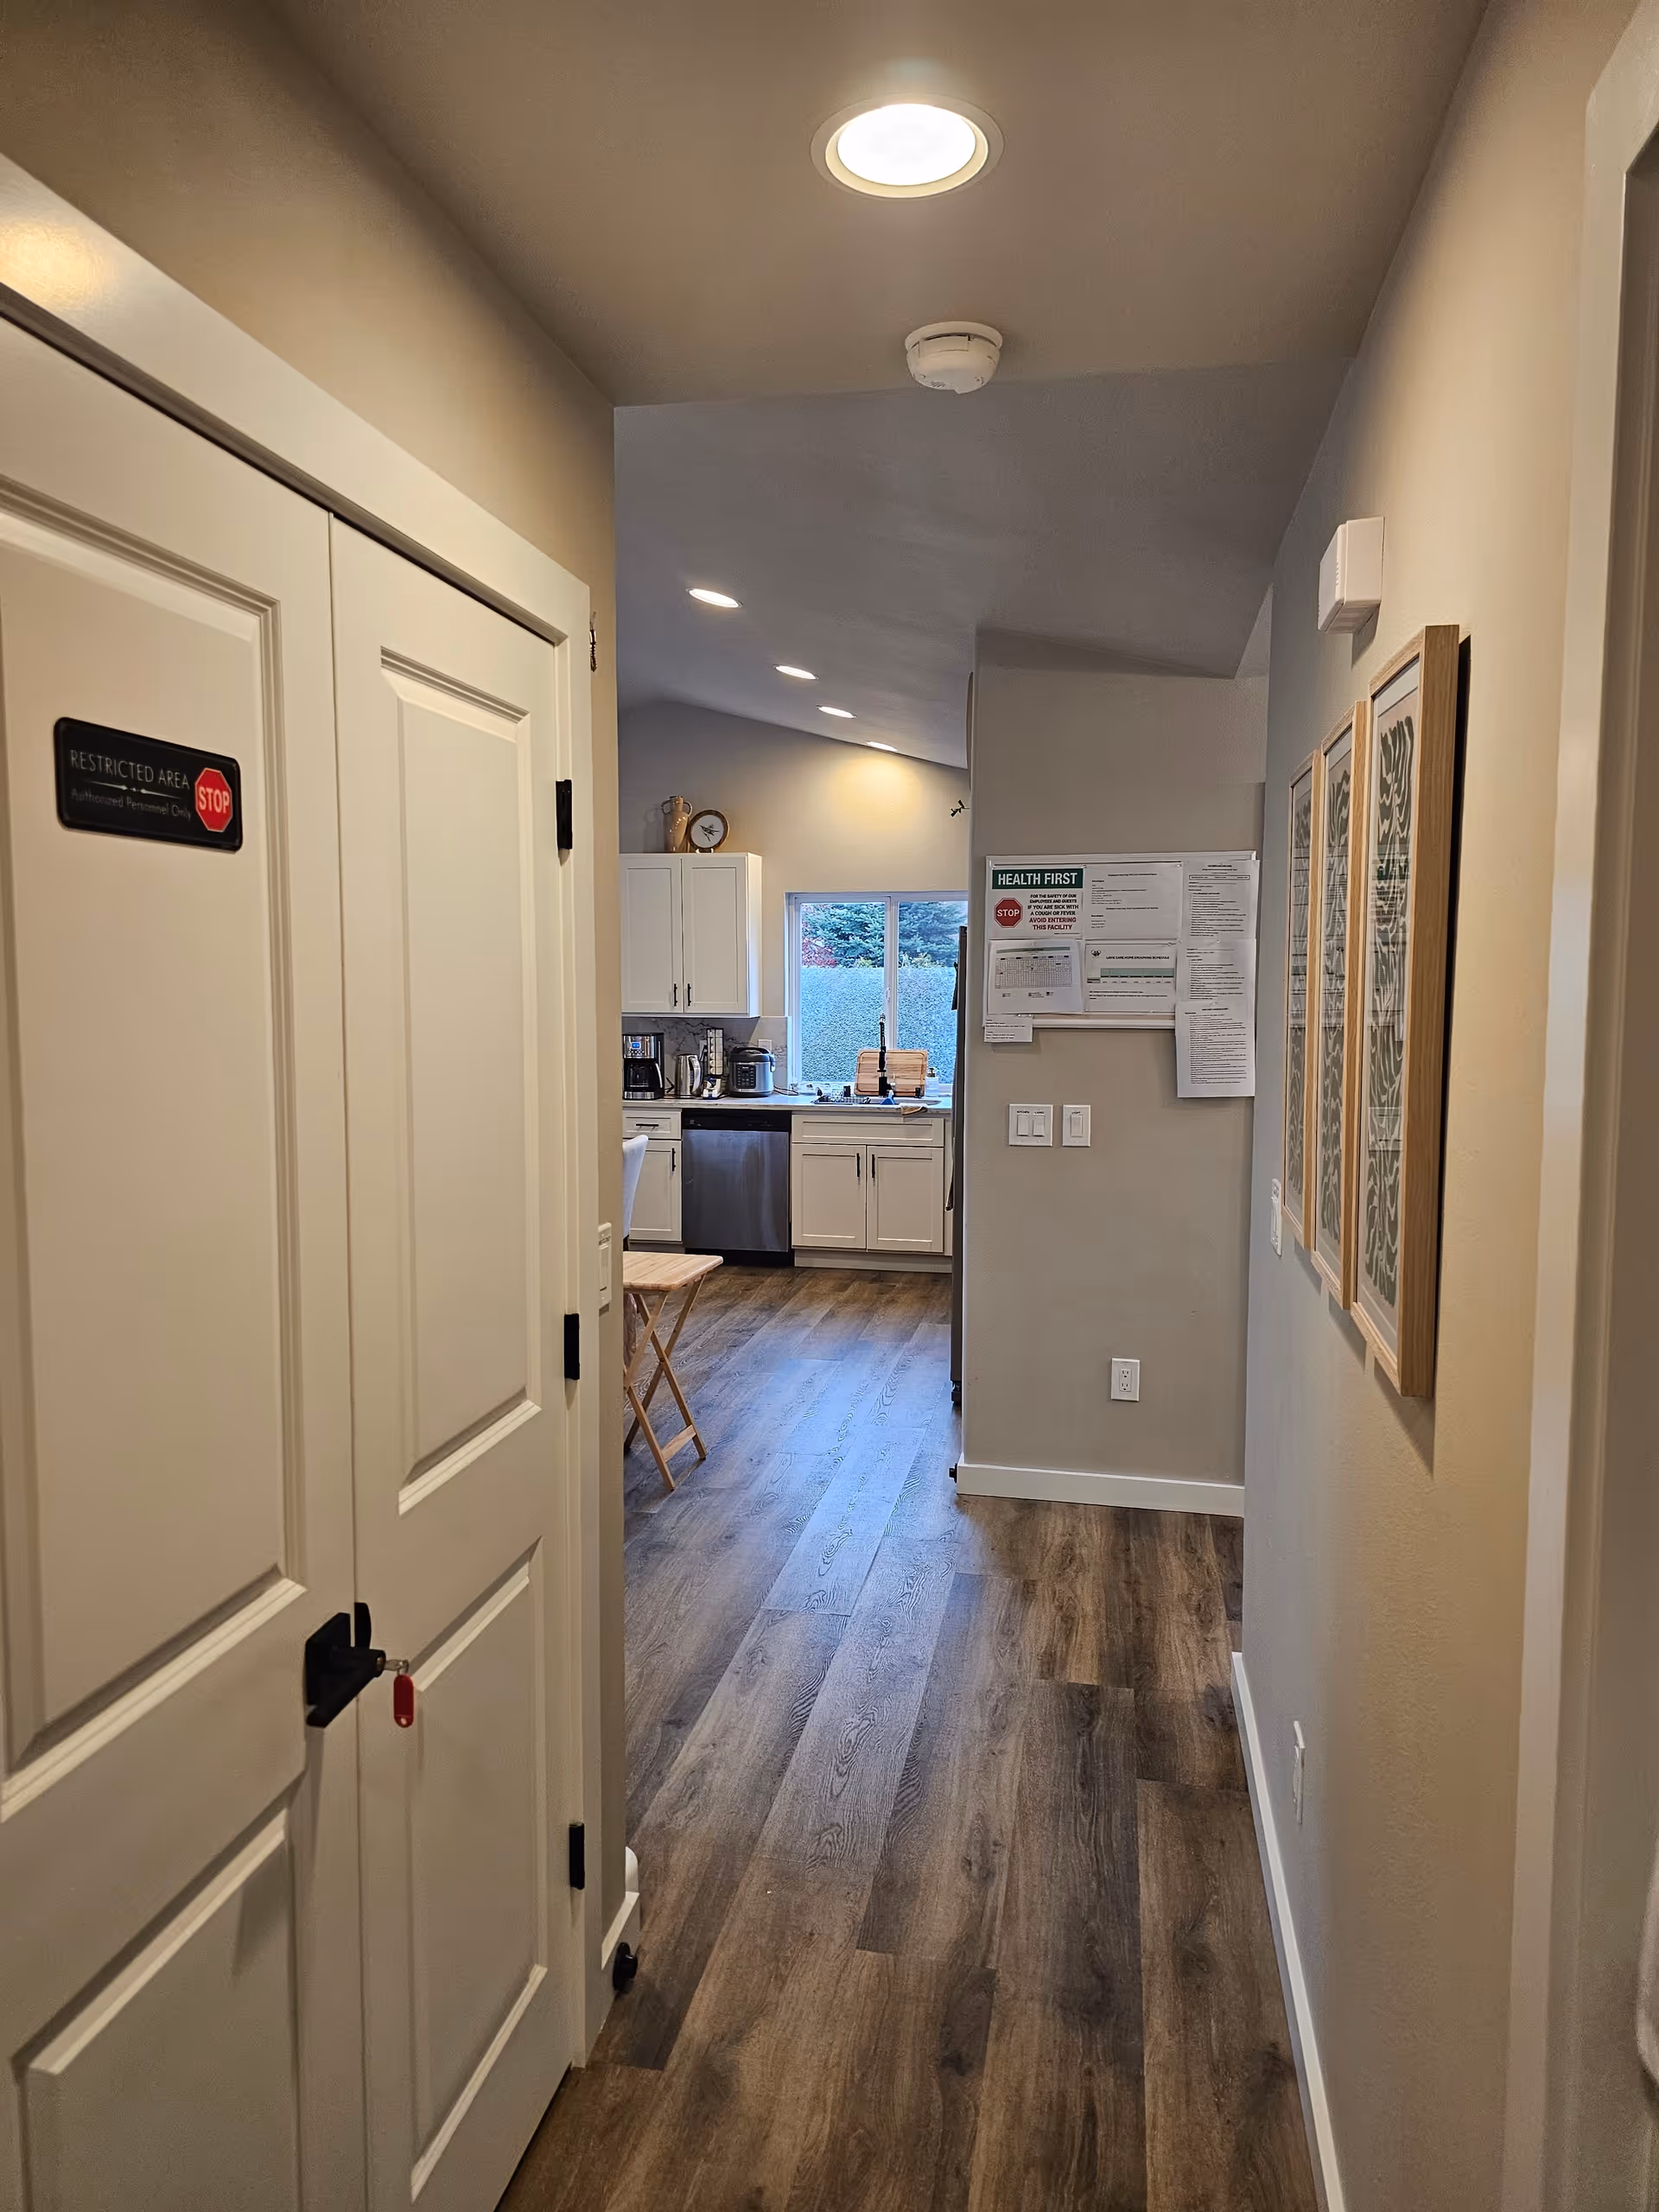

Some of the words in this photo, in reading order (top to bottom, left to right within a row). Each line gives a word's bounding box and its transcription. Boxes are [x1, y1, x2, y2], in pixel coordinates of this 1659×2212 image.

[70, 749, 154, 783] RESTRICTED
[158, 768, 190, 791] AREA
[126, 796, 169, 816] Personnel
[171, 804, 191, 822] Only
[198, 786, 231, 814] STOP
[998, 873, 1040, 885] HEALTH
[1044, 872, 1077, 885] FIRST
